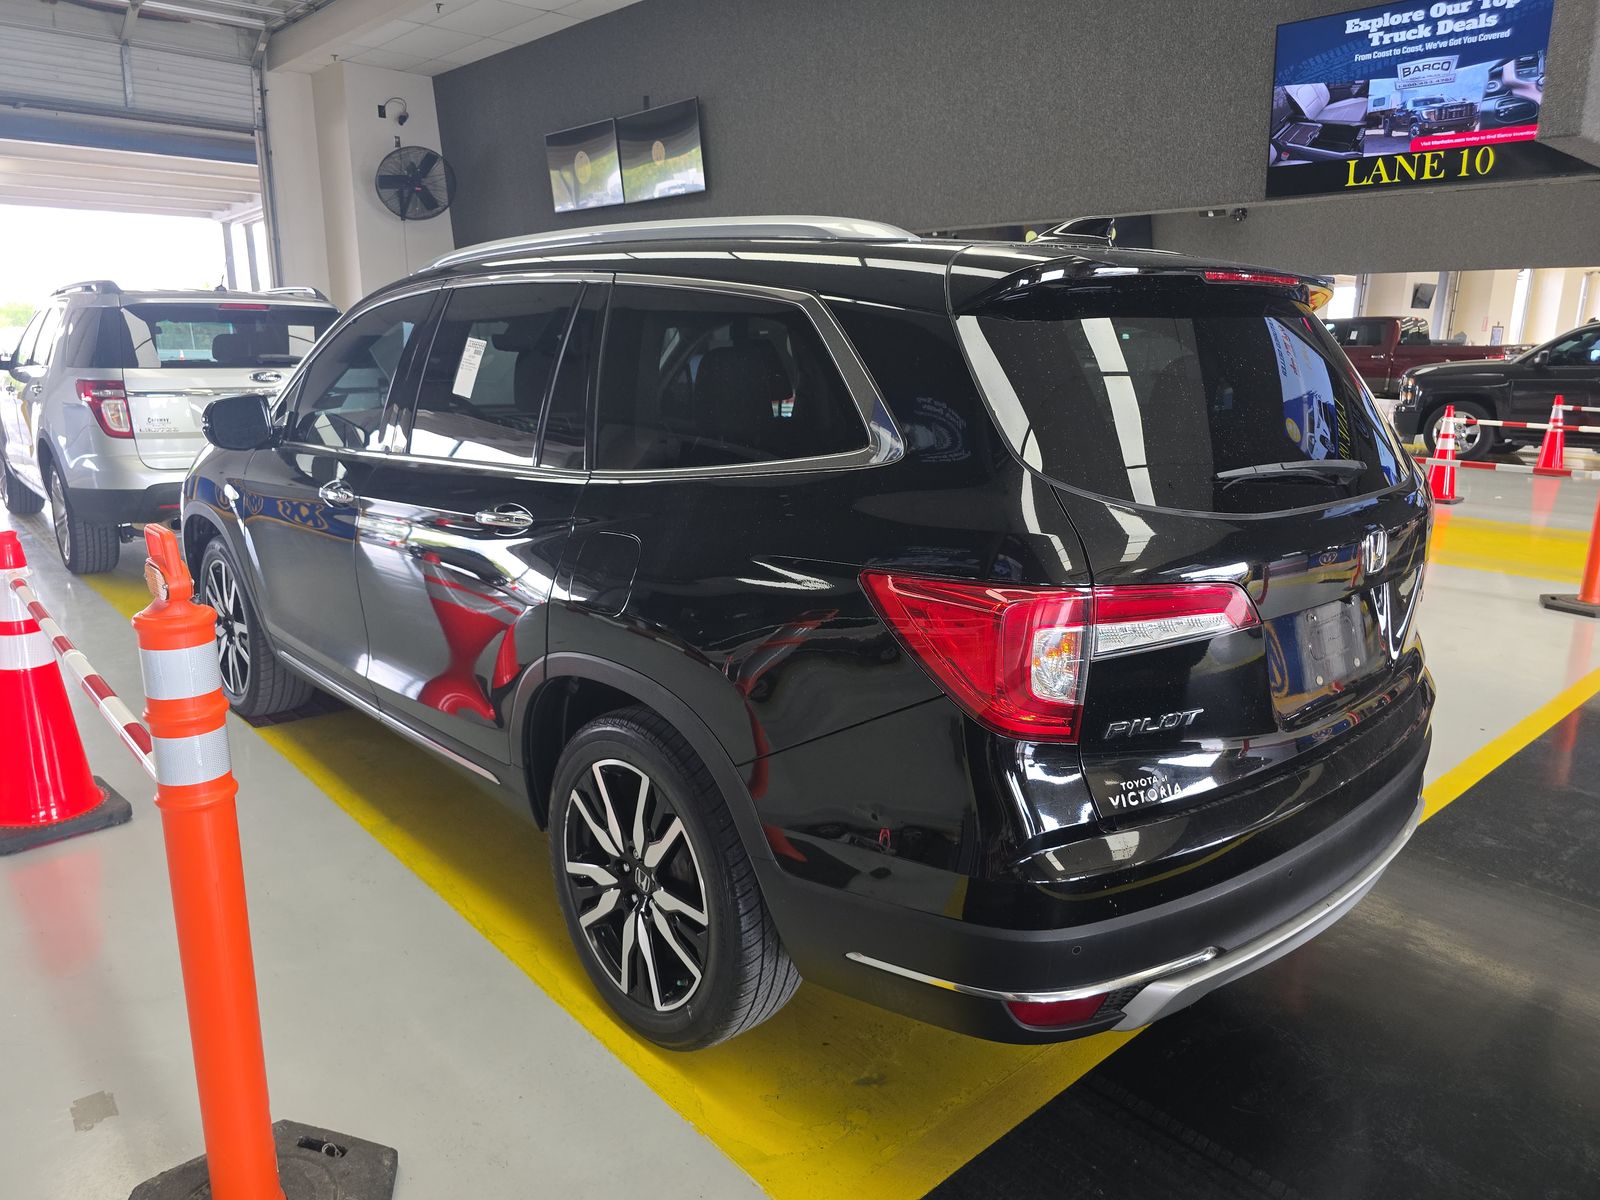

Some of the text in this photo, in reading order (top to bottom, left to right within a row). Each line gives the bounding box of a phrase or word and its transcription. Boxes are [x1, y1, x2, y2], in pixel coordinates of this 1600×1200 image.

[1345, 0, 1521, 34] Explore Our Top
[1368, 12, 1500, 47] Truck Deals
[1355, 53, 1372, 62] From
[1373, 49, 1393, 59] Coast
[1402, 44, 1424, 54] Coast,
[1425, 40, 1448, 51] We've
[1449, 37, 1463, 47] Got
[1463, 35, 1478, 44] You
[1478, 28, 1513, 42] Covered
[1402, 61, 1451, 78] BARCO
[1345, 146, 1495, 187] LANE 10
[1104, 708, 1204, 740] PILOT
[1109, 782, 1183, 809] VICTORIA
[1120, 775, 1158, 791] TOYOTA
